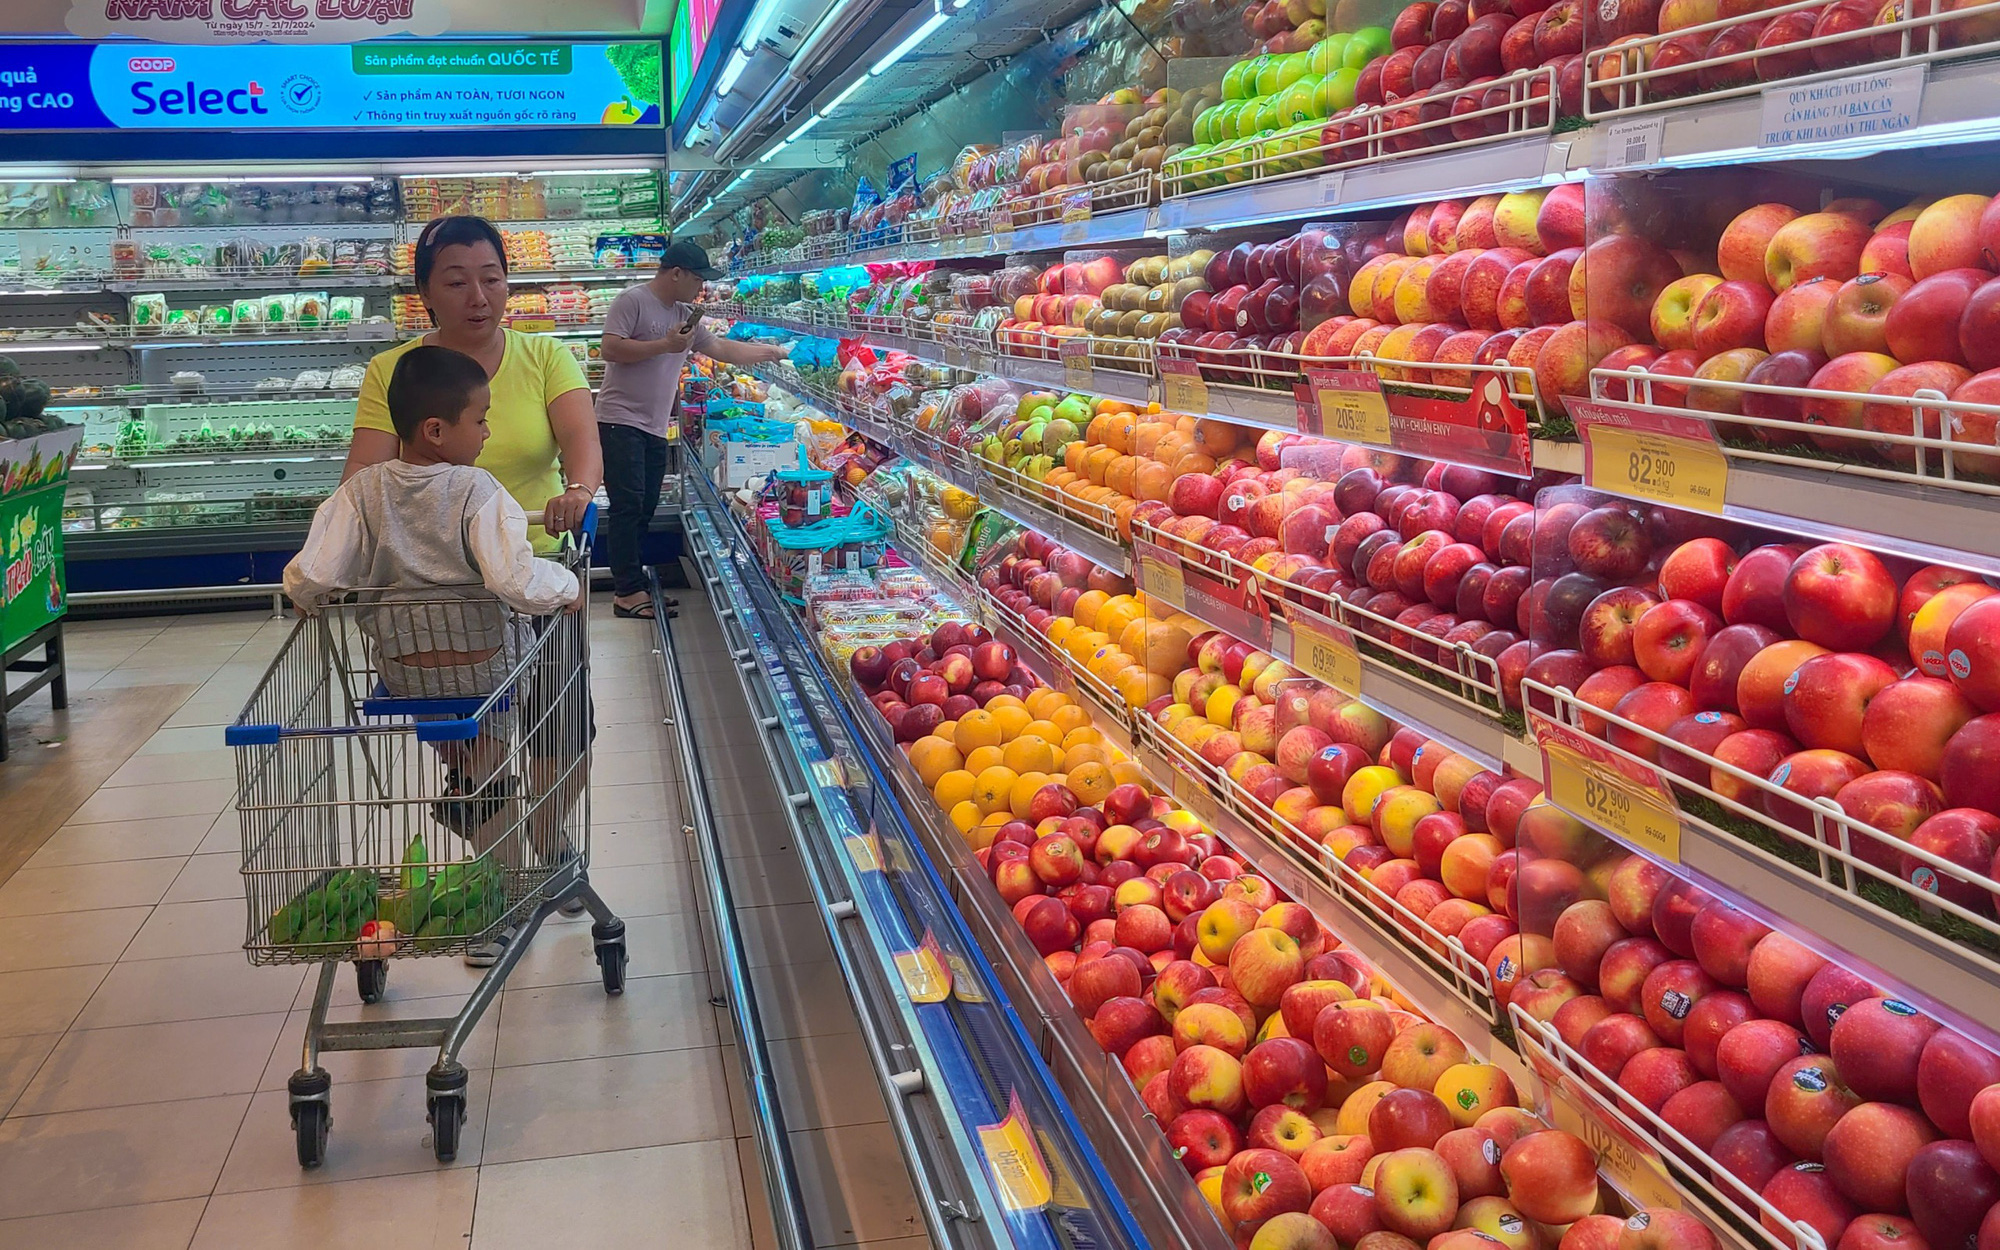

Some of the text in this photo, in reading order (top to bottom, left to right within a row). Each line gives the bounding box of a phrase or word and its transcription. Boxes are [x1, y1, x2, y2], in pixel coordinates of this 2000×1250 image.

[205, 21, 218, 29] Từ
[219, 21, 243, 30] ngày
[245, 21, 263, 29] 15/7
[271, 21, 315, 29] 21/7/2024
[129, 60, 174, 71] COOP
[364, 48, 561, 69] Sản phẩm đạt chuẩn QUỐC TẾ
[0, 66, 38, 87] quả
[27, 93, 74, 109] CAO
[131, 81, 269, 115] Select
[376, 89, 397, 101] Sản
[400, 89, 433, 104] phẩm
[435, 91, 452, 100] AN
[496, 90, 526, 100] TƯƠI
[529, 90, 565, 101] NGON
[1789, 76, 1892, 105] QUÝ KHÁCH VUI LÒNG
[366, 108, 577, 123] Thông tin truy xuất nguồn gốc rõ ràng
[1803, 105, 1830, 121] HÀNG
[1848, 99, 1869, 116] BÀN
[1765, 128, 1793, 144] TRƯỚC
[1796, 127, 1813, 141] KHI
[1815, 126, 1828, 138] RA
[1858, 118, 1878, 132] THU
[1880, 113, 1911, 131] NGÂN
